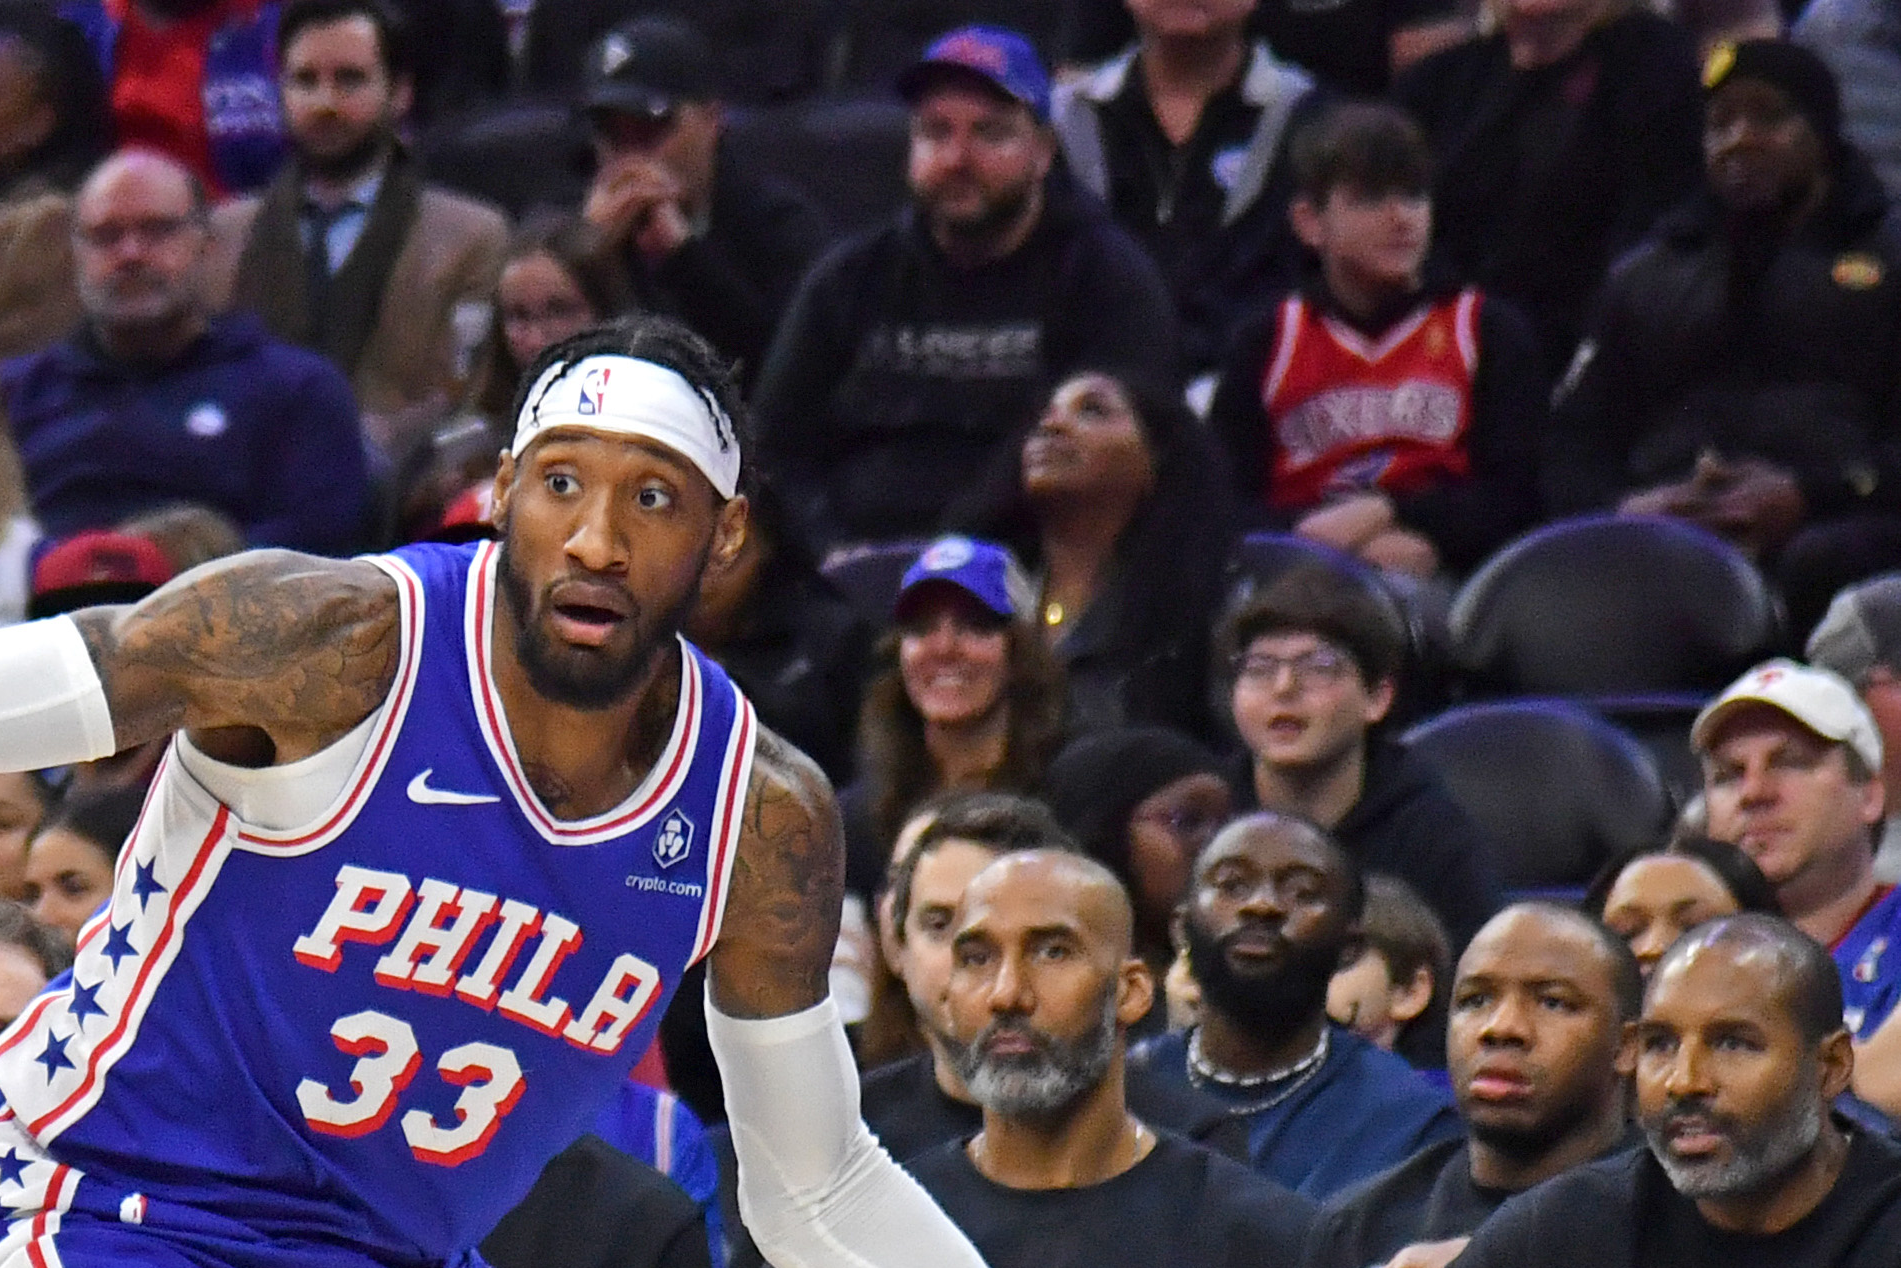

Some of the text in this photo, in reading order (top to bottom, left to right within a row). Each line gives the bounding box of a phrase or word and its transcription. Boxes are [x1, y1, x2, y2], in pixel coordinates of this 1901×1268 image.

[292, 864, 663, 1057] PHILA
[625, 875, 702, 898] crypto.com
[295, 1009, 528, 1168] 33
